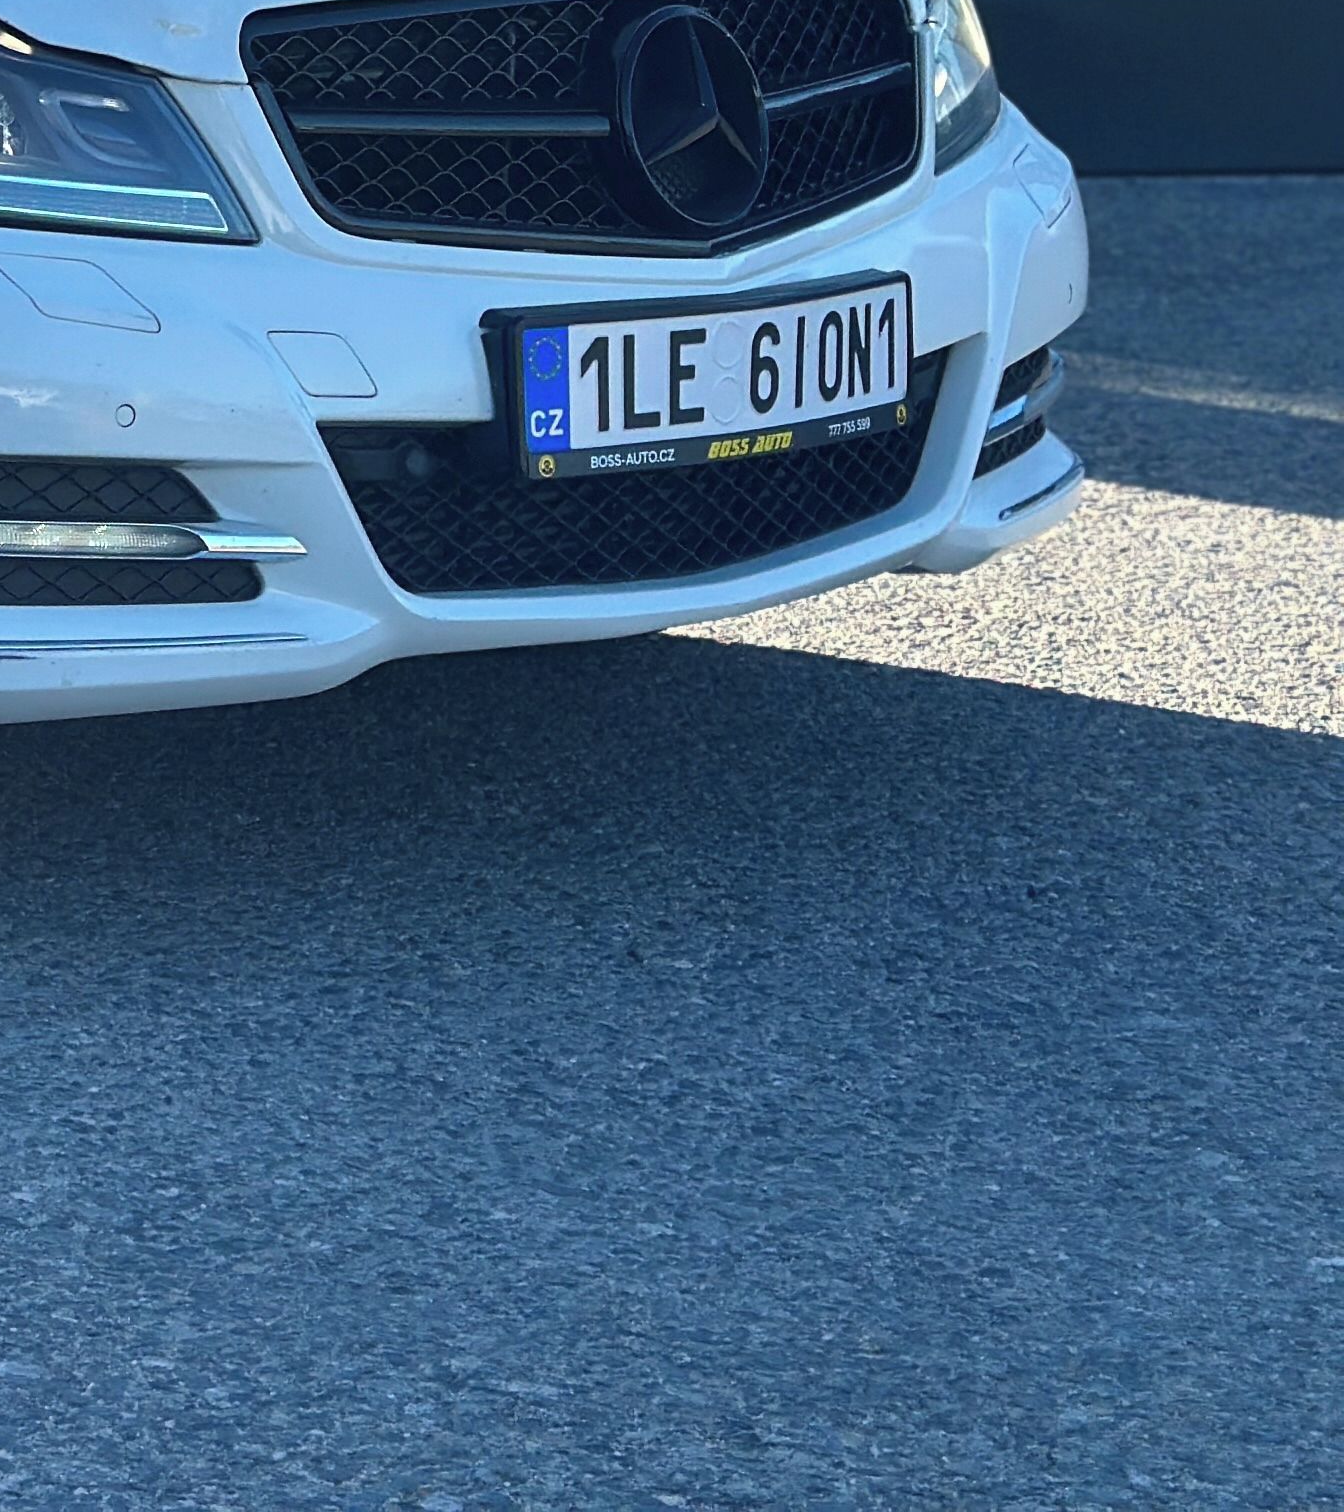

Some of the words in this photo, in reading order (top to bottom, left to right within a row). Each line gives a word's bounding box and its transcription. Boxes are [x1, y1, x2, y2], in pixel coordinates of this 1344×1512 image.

[580, 328, 707, 432] 1LE
[530, 408, 564, 439] CZ
[590, 448, 676, 469] BOSS-AUTO.CZ
[707, 437, 750, 460] BOSS
[751, 430, 793, 454] AUTO
